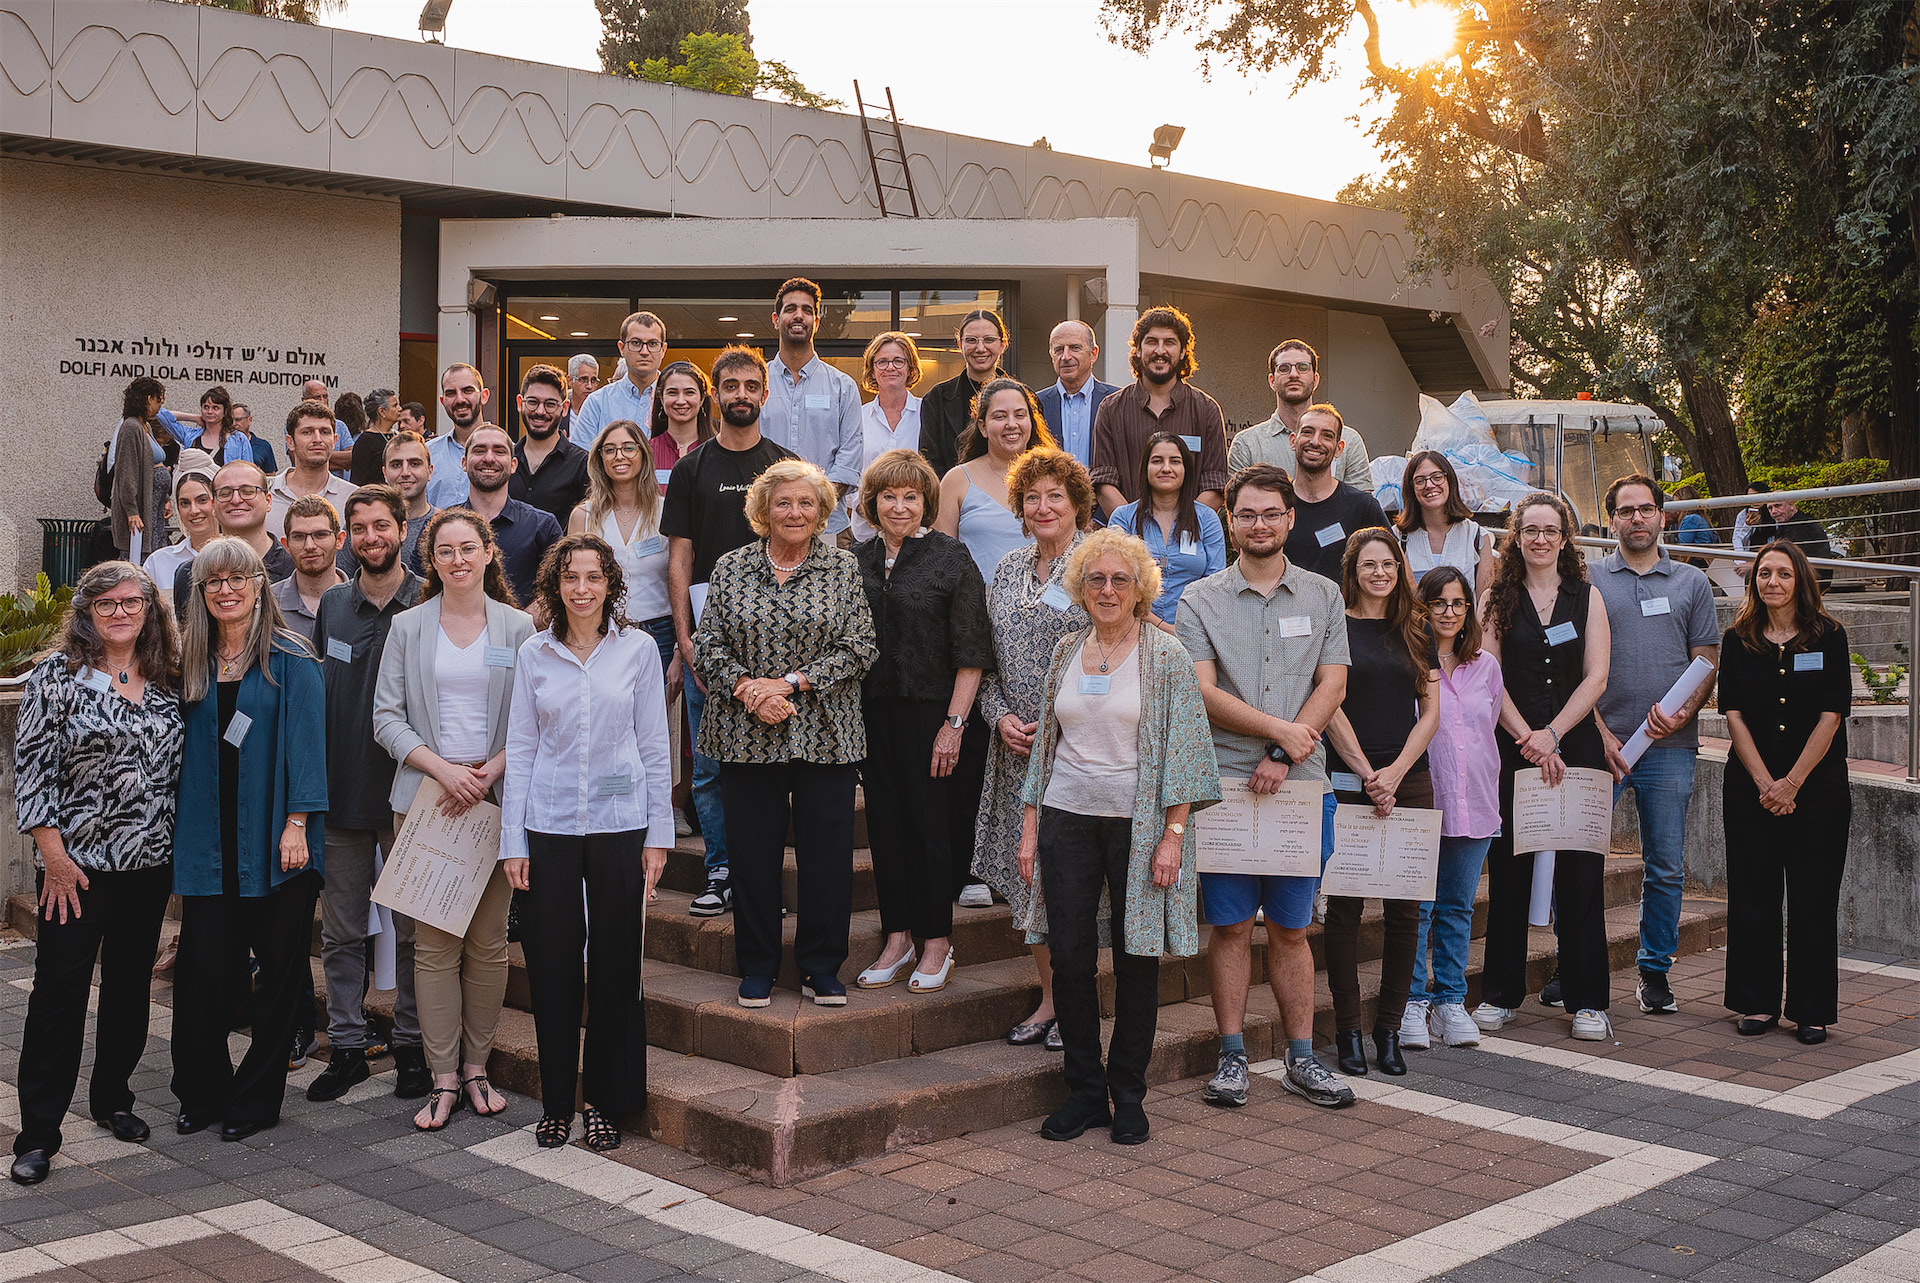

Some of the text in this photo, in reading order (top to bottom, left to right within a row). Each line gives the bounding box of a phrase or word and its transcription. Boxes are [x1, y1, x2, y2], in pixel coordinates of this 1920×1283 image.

[75, 338, 124, 354] אבנר
[131, 336, 179, 357] ולולה
[186, 341, 234, 360] דולפי
[286, 347, 326, 366] אולם
[60, 360, 106, 377] DOLFI
[110, 363, 146, 378] AND
[150, 366, 190, 381] LOLA
[194, 368, 244, 384] EBNER
[1359, 824, 1376, 832] certify
[395, 886, 404, 899] This
[405, 854, 420, 875] certify
